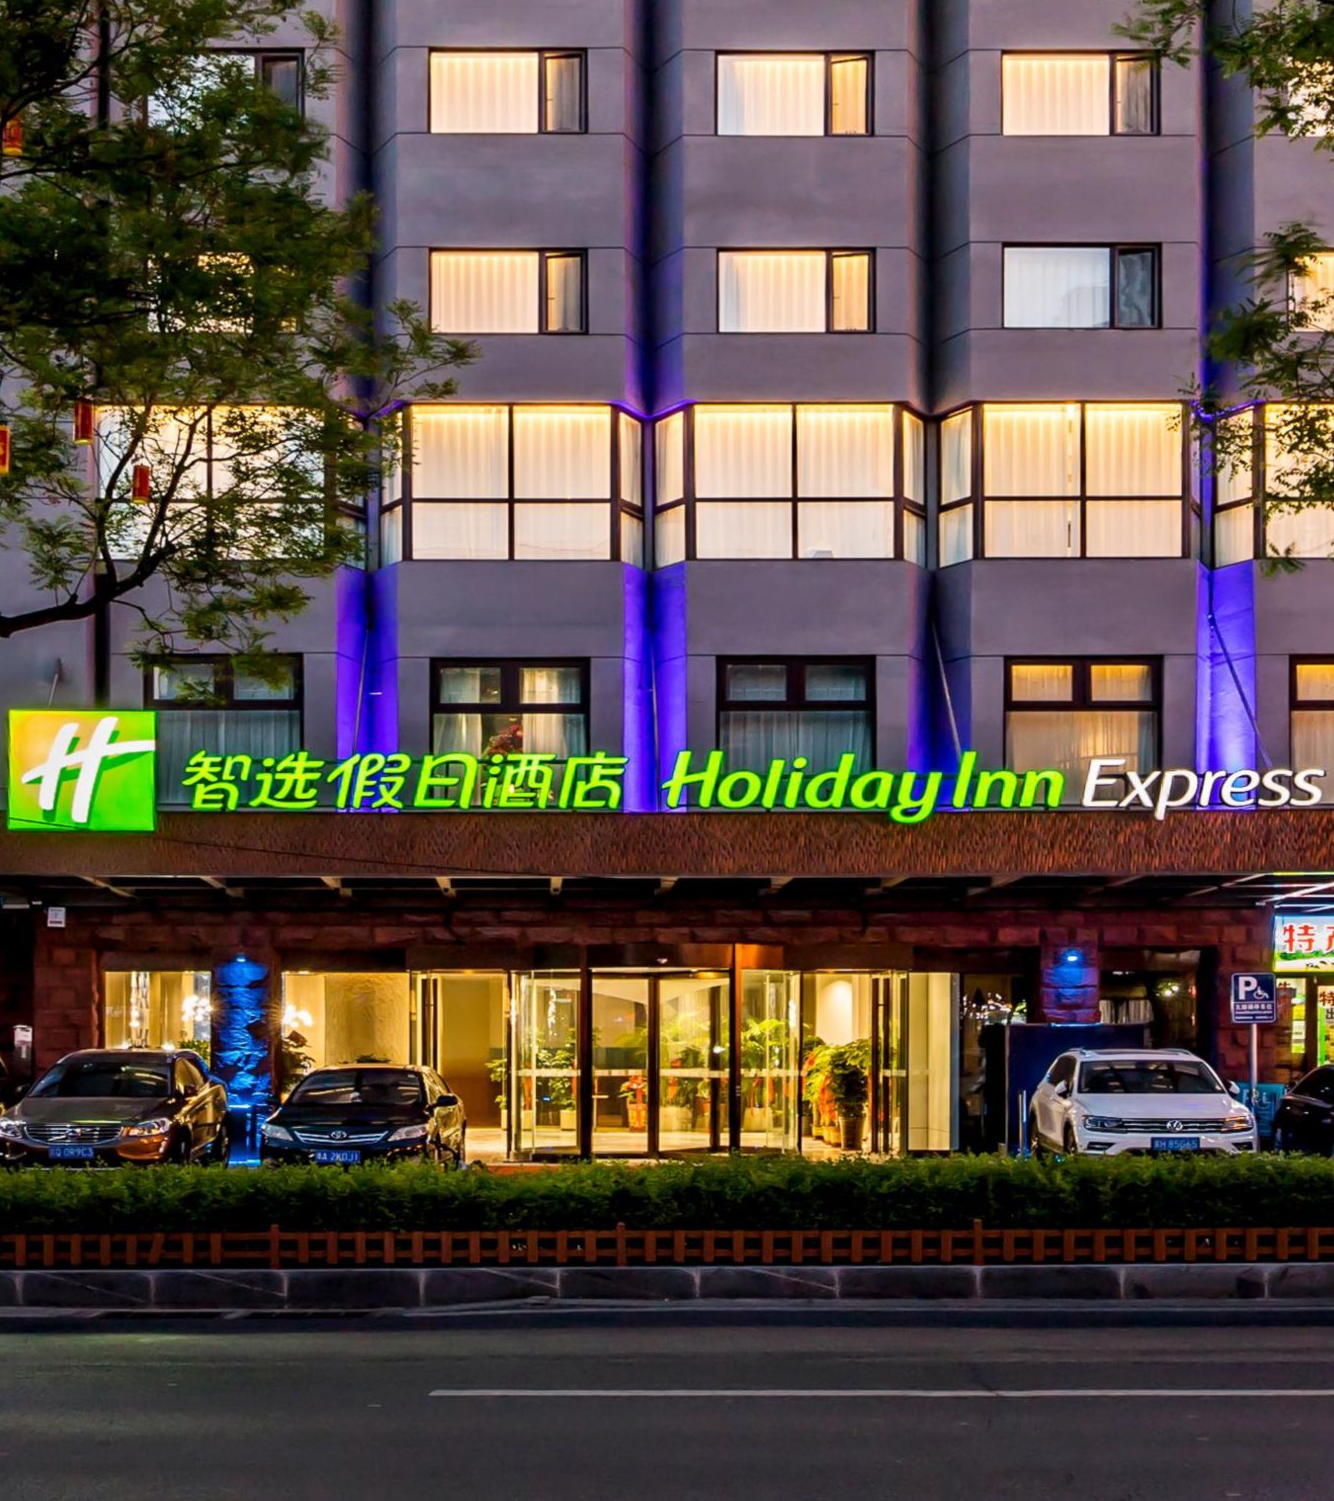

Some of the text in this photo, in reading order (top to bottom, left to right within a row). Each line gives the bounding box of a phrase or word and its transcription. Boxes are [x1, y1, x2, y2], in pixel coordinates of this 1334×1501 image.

[181, 749, 626, 812] 智选假日酒店
[660, 748, 1325, 825] Holiday Inn Express
[1238, 976, 1258, 1000] P
